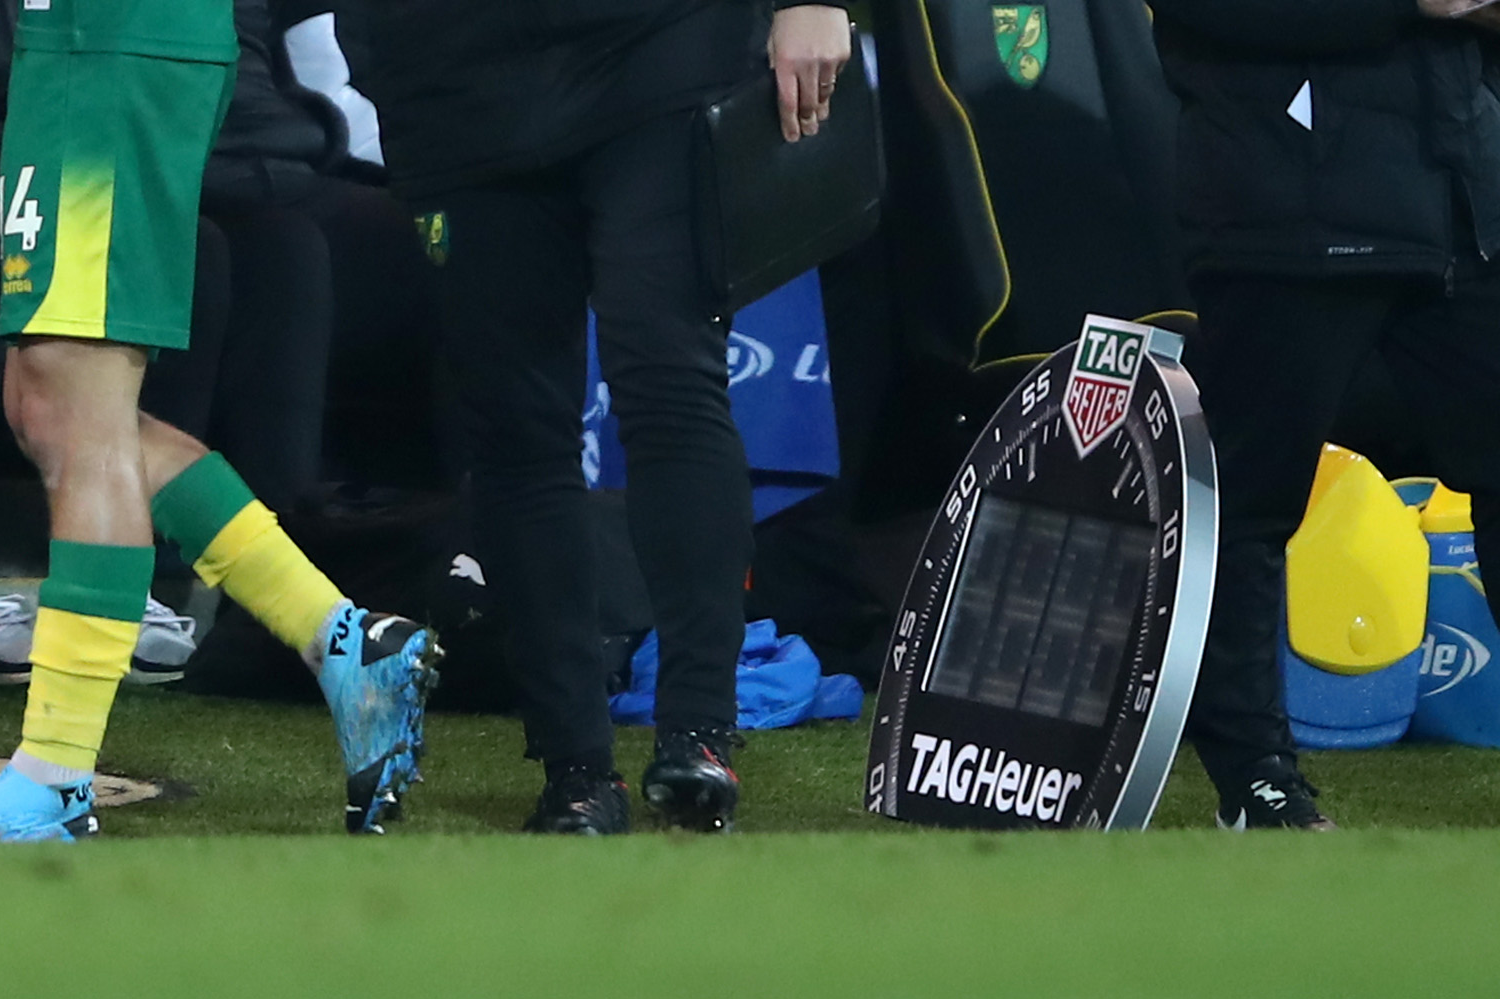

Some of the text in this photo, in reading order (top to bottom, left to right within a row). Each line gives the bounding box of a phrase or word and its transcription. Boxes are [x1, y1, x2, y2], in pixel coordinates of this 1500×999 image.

[1088, 330, 1139, 375] TAG
[1022, 369, 1050, 416] 55
[1070, 380, 1128, 443] HEUER
[1145, 390, 1168, 440] 05
[945, 464, 977, 524] 50
[1162, 510, 1178, 559] 10
[893, 609, 917, 672] 45
[1134, 669, 1156, 712] 15
